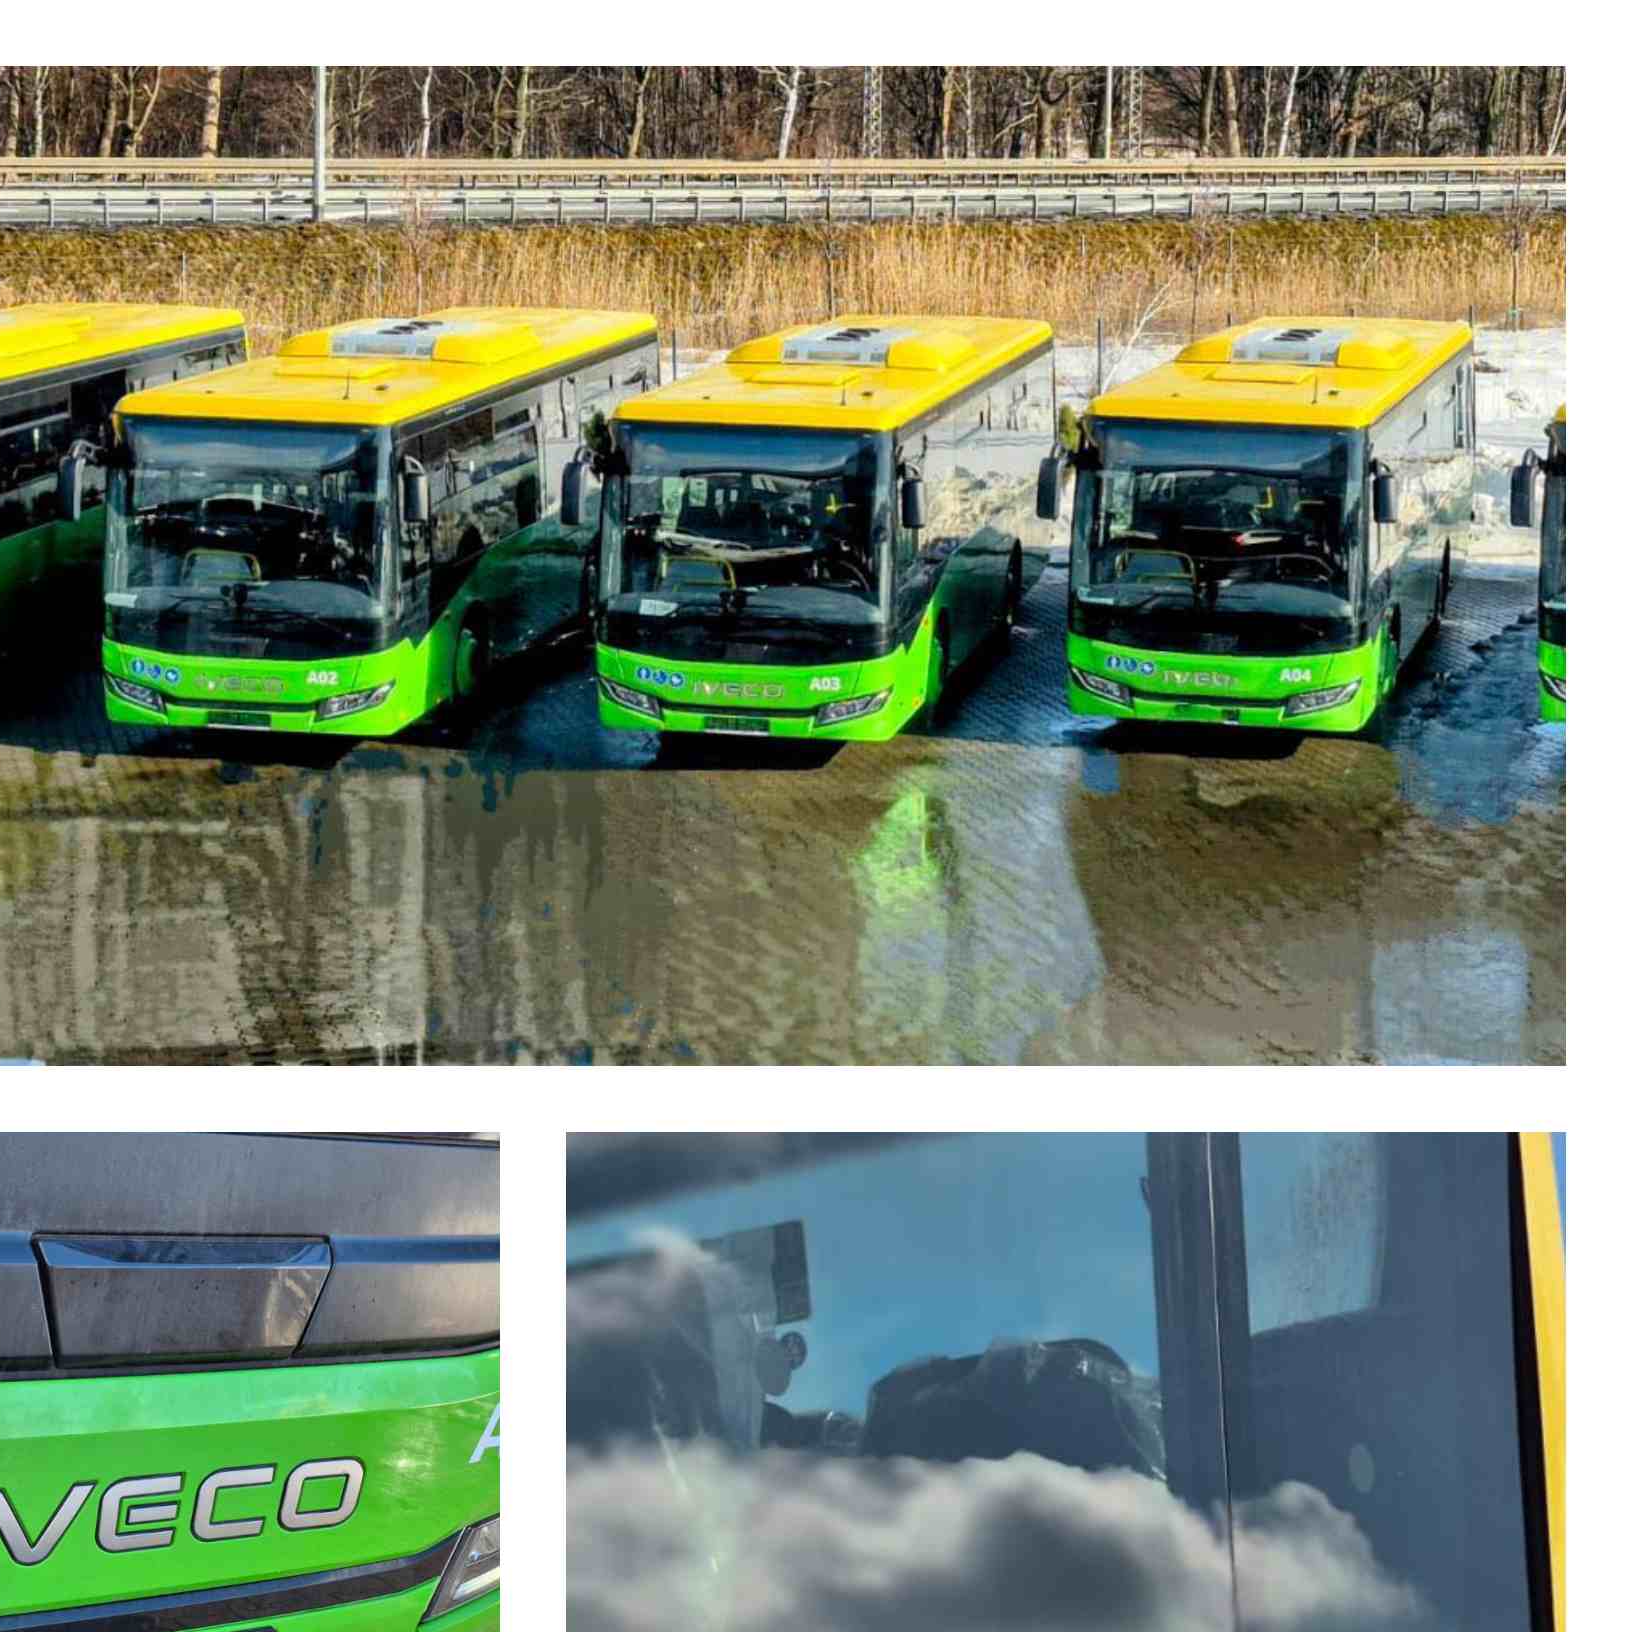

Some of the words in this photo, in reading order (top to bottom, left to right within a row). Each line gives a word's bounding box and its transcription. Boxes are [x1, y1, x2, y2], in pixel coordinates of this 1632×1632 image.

[306, 669, 340, 685] A02
[1279, 667, 1313, 683] A04
[693, 681, 785, 698] IVECO
[809, 676, 842, 691] A03
